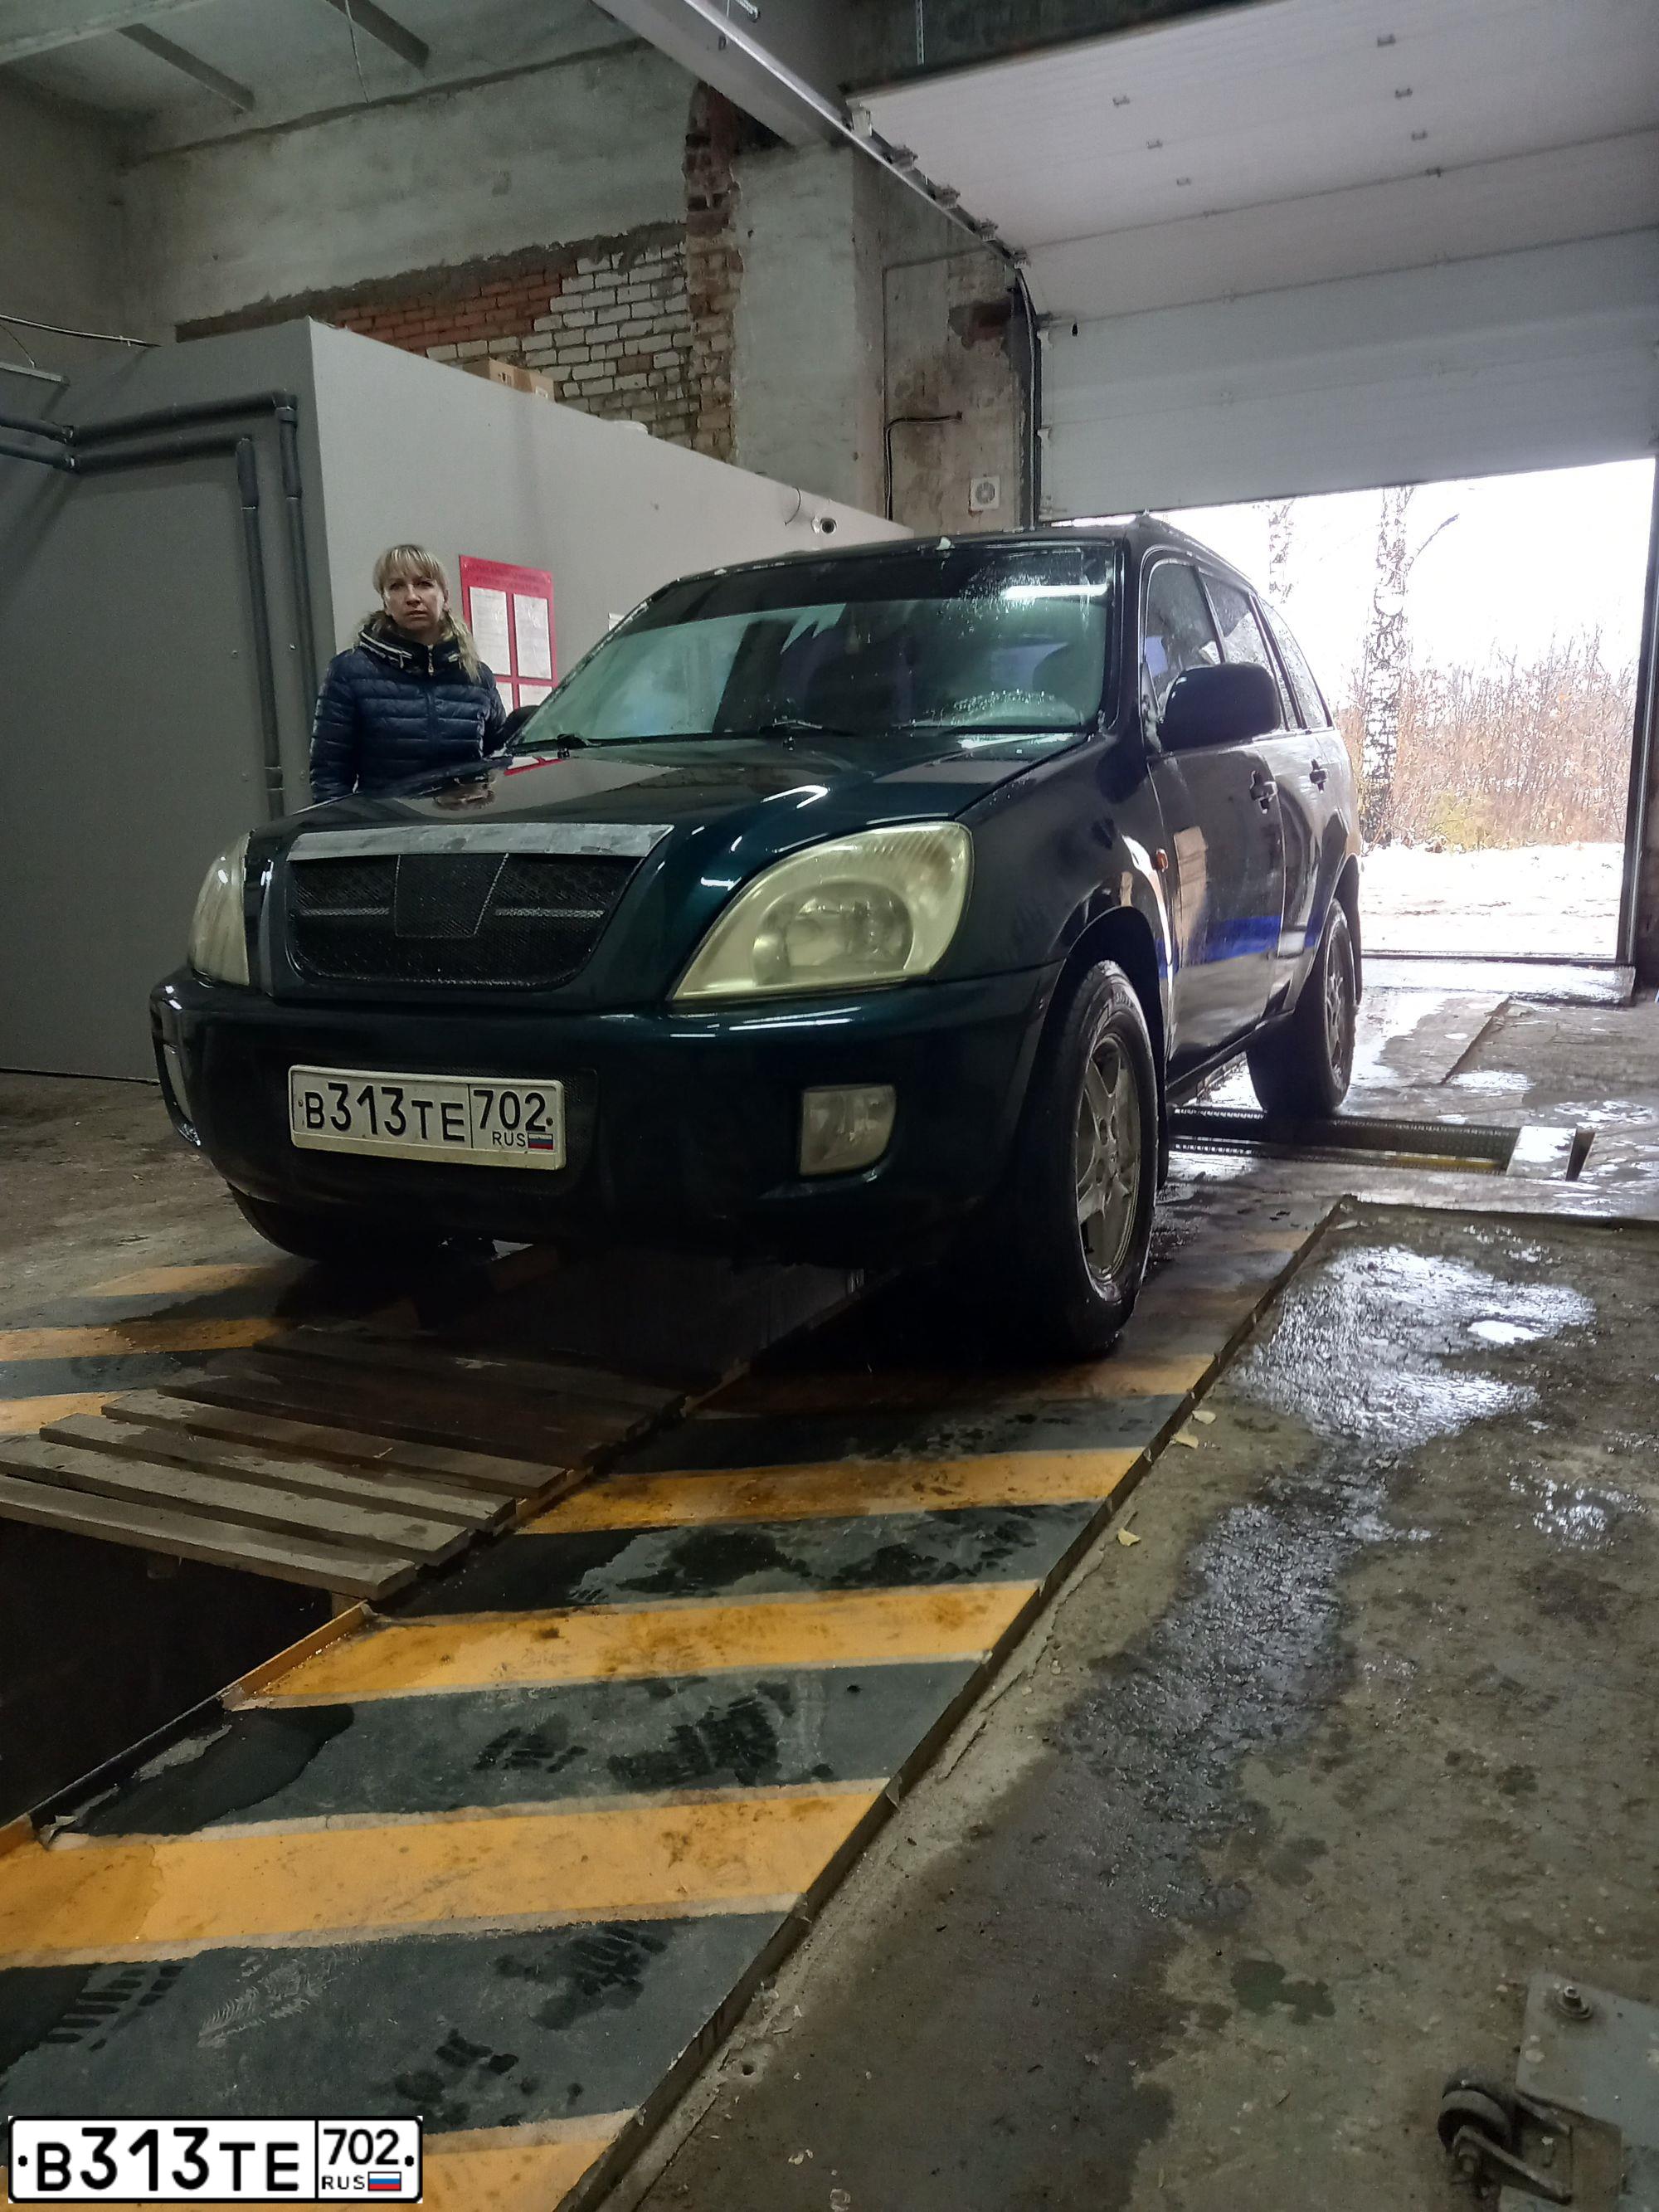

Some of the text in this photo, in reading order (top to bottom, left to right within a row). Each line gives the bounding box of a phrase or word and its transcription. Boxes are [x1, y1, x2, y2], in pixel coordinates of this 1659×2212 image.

[304, 1082, 546, 1142] В313ТЕ 702
[492, 1131, 526, 1147] RUS
